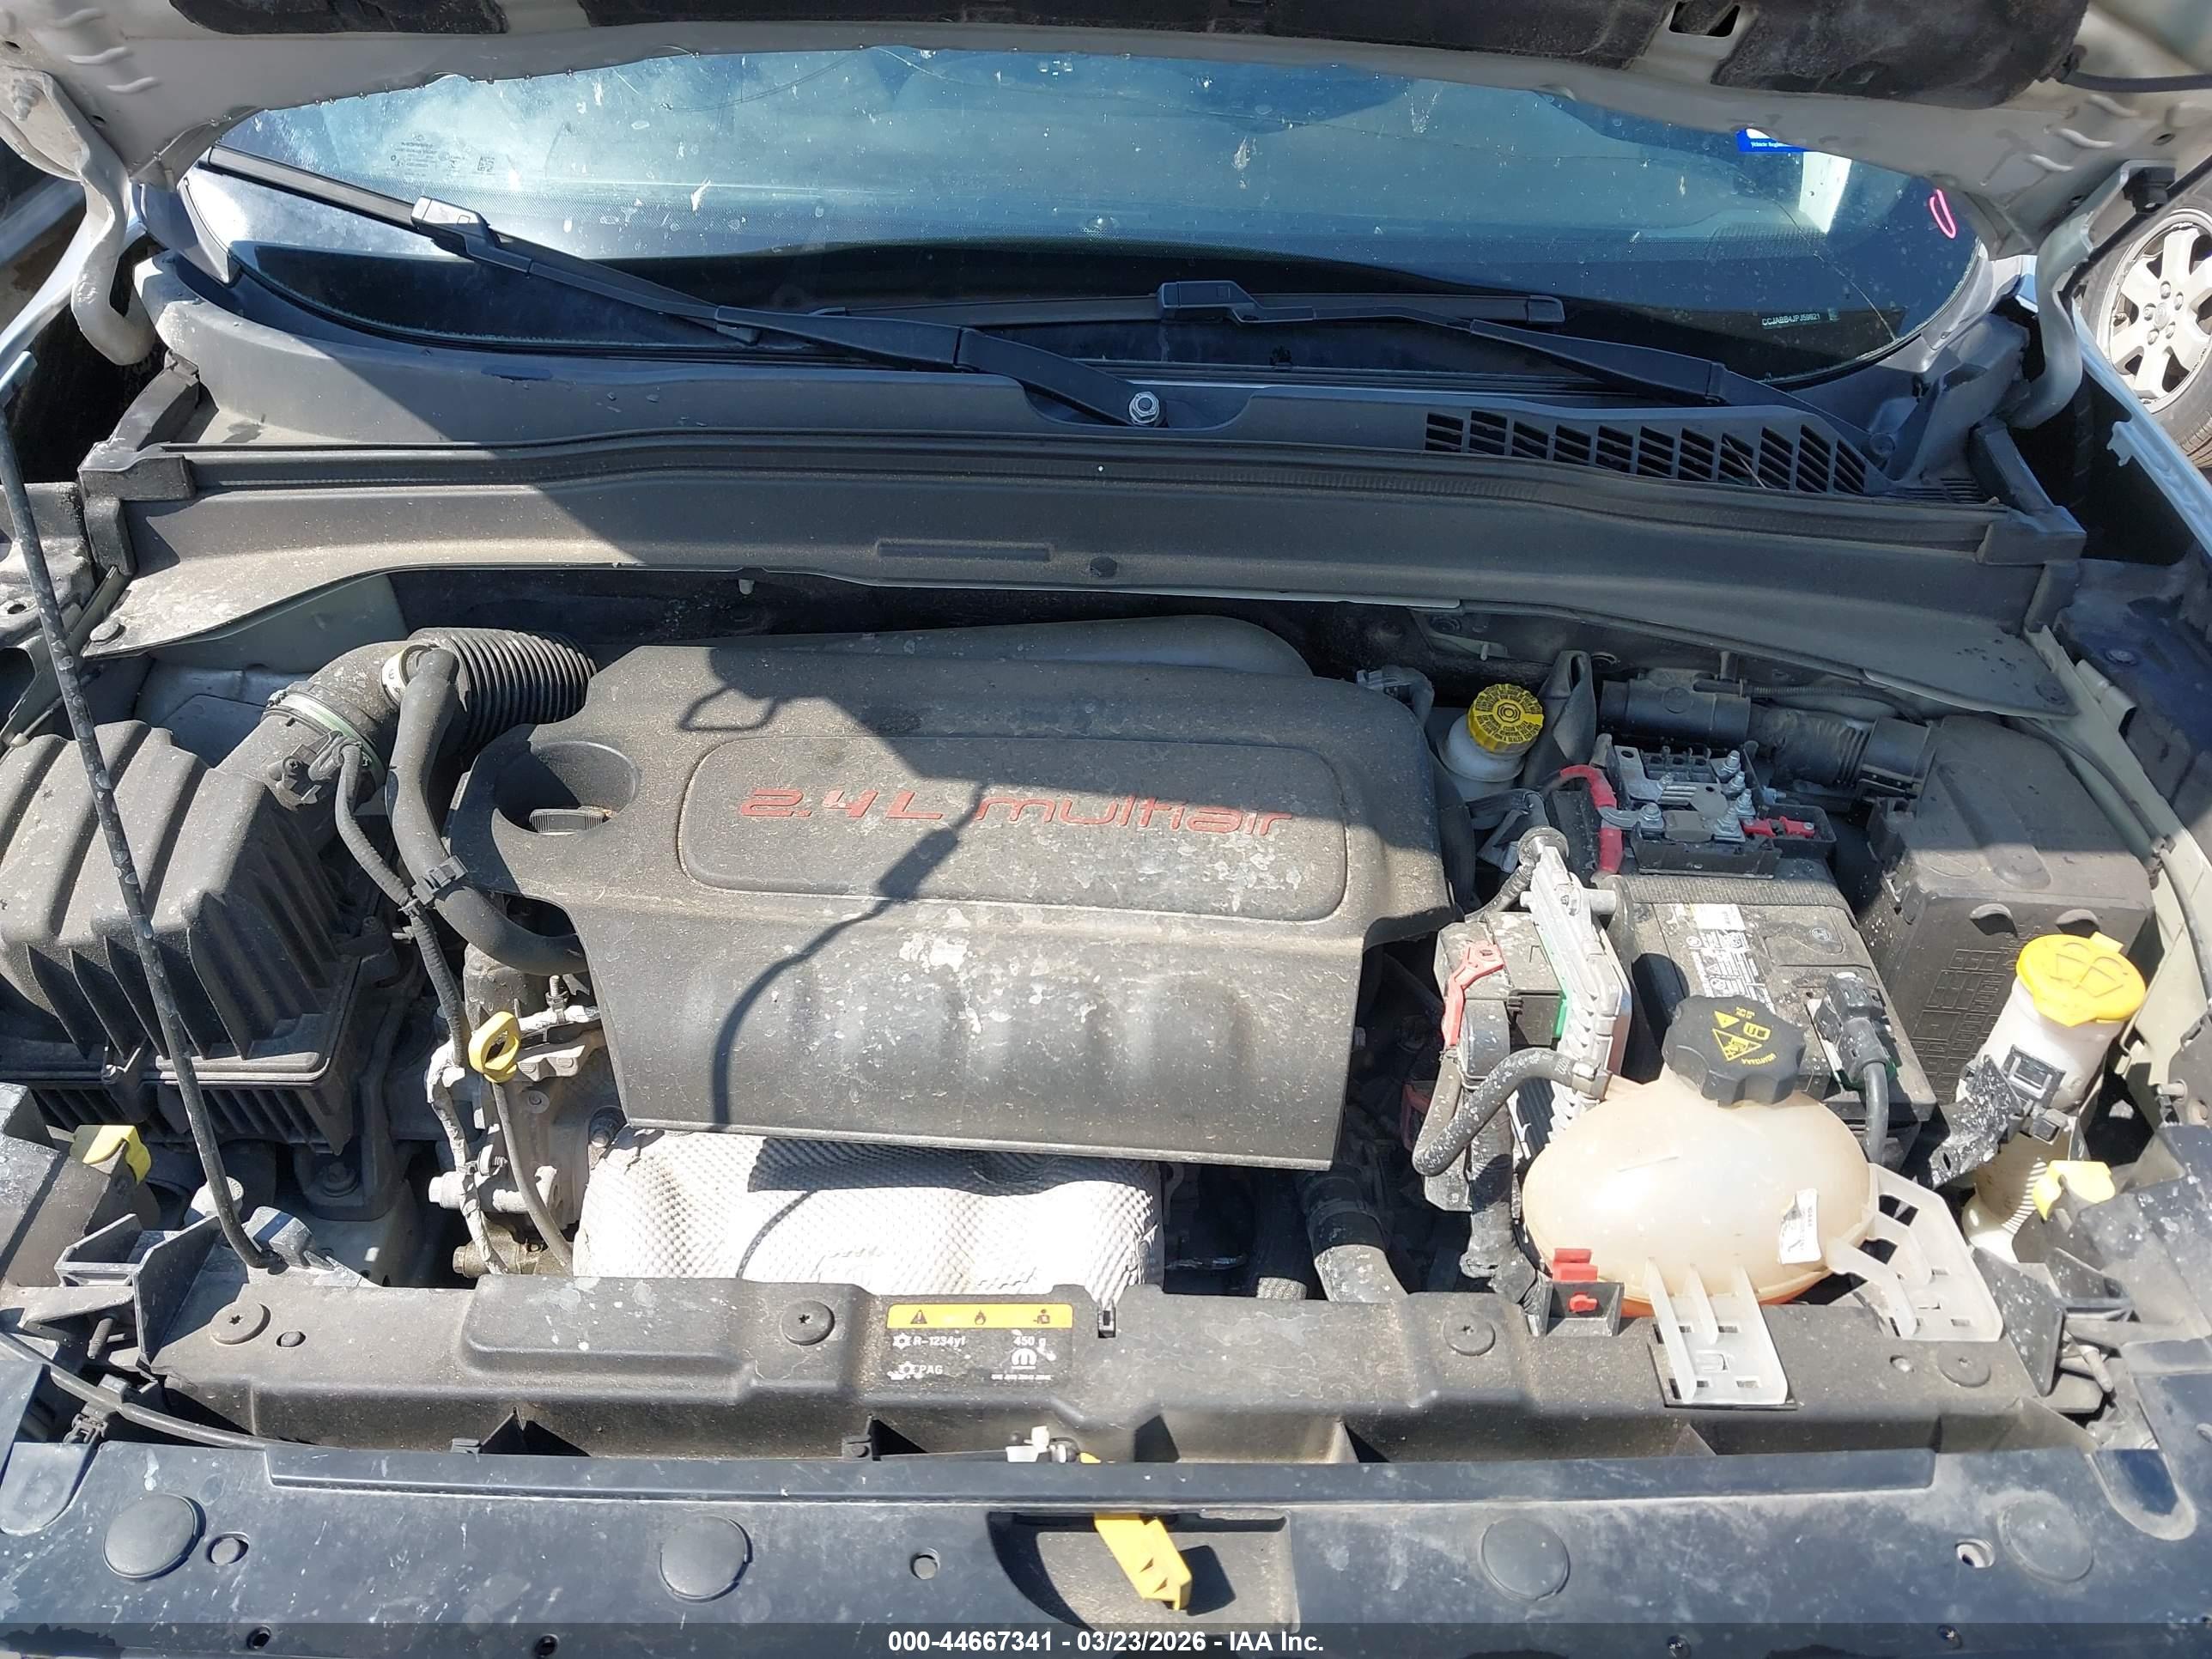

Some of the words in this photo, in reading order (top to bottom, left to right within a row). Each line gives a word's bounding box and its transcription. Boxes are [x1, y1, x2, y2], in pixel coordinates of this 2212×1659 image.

[971, 793, 1294, 836] multiair
[913, 1336, 967, 1348] R-1234yf
[1013, 1335, 1036, 1346] 450
[919, 1364, 944, 1376] PAG
